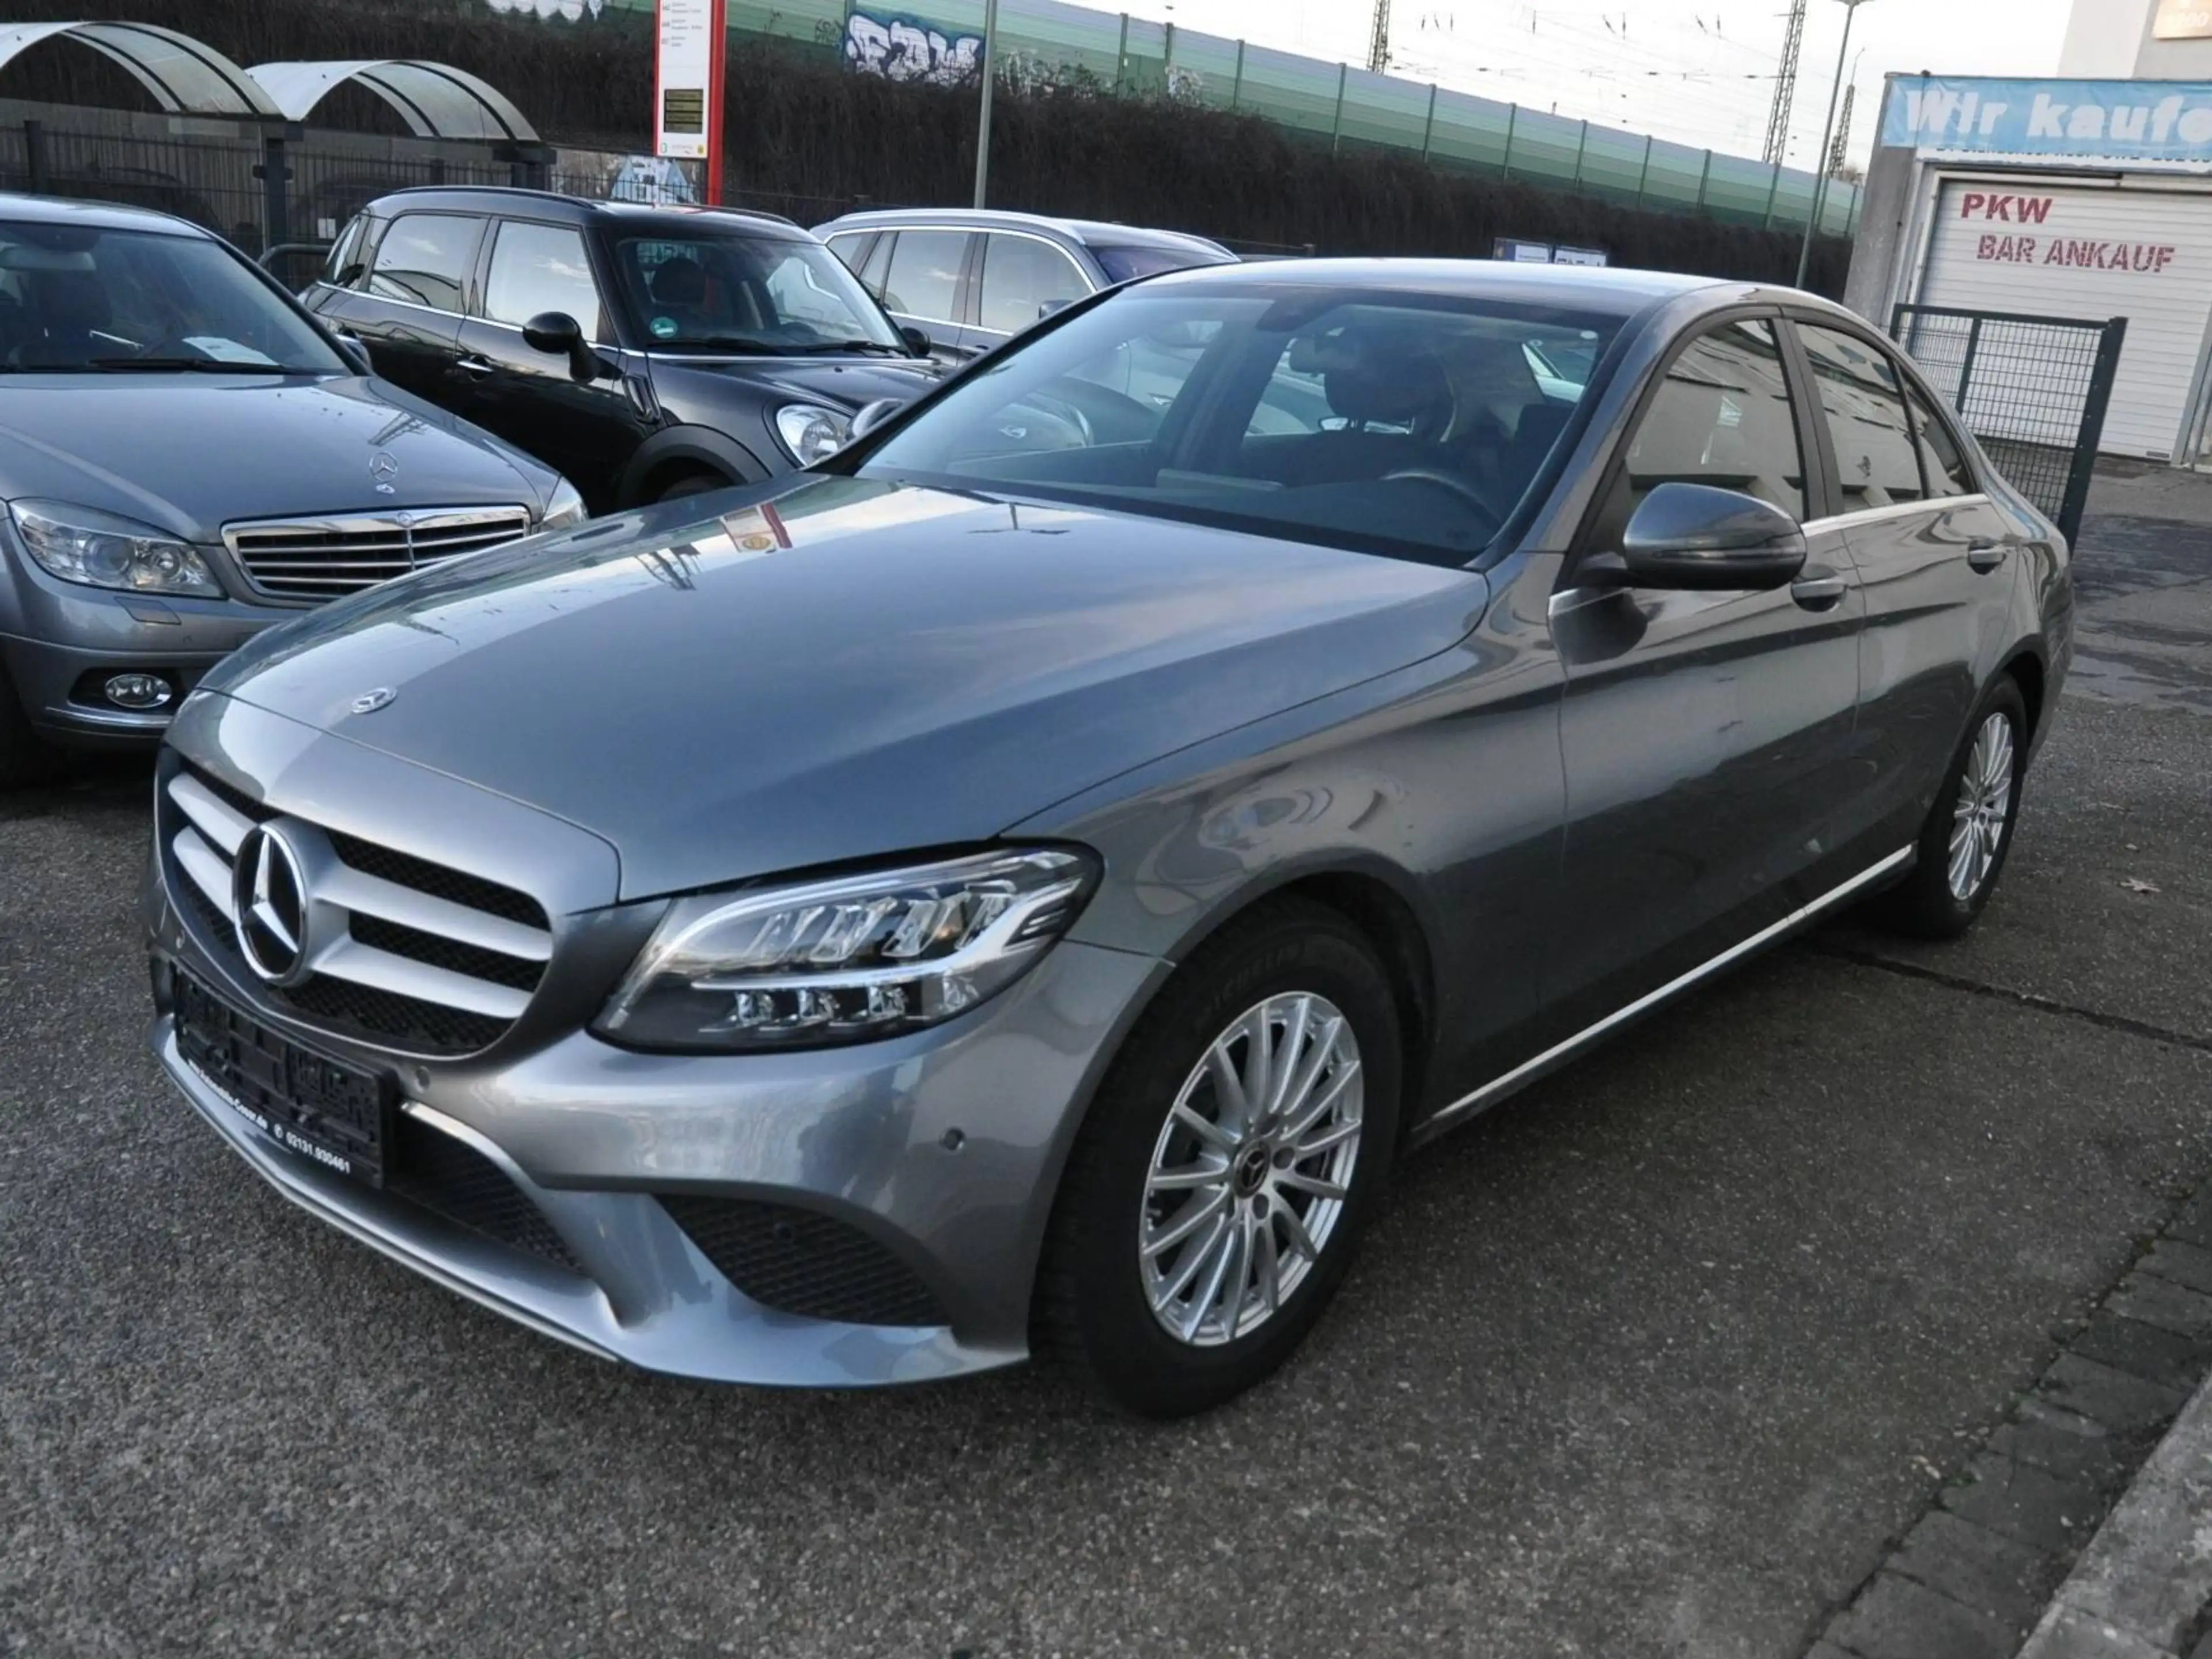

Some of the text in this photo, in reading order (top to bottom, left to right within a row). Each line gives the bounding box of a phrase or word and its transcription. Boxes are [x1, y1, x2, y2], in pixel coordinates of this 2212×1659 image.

[1960, 192, 2053, 224] PKW
[1976, 234, 2175, 272] BAR ANKAUF
